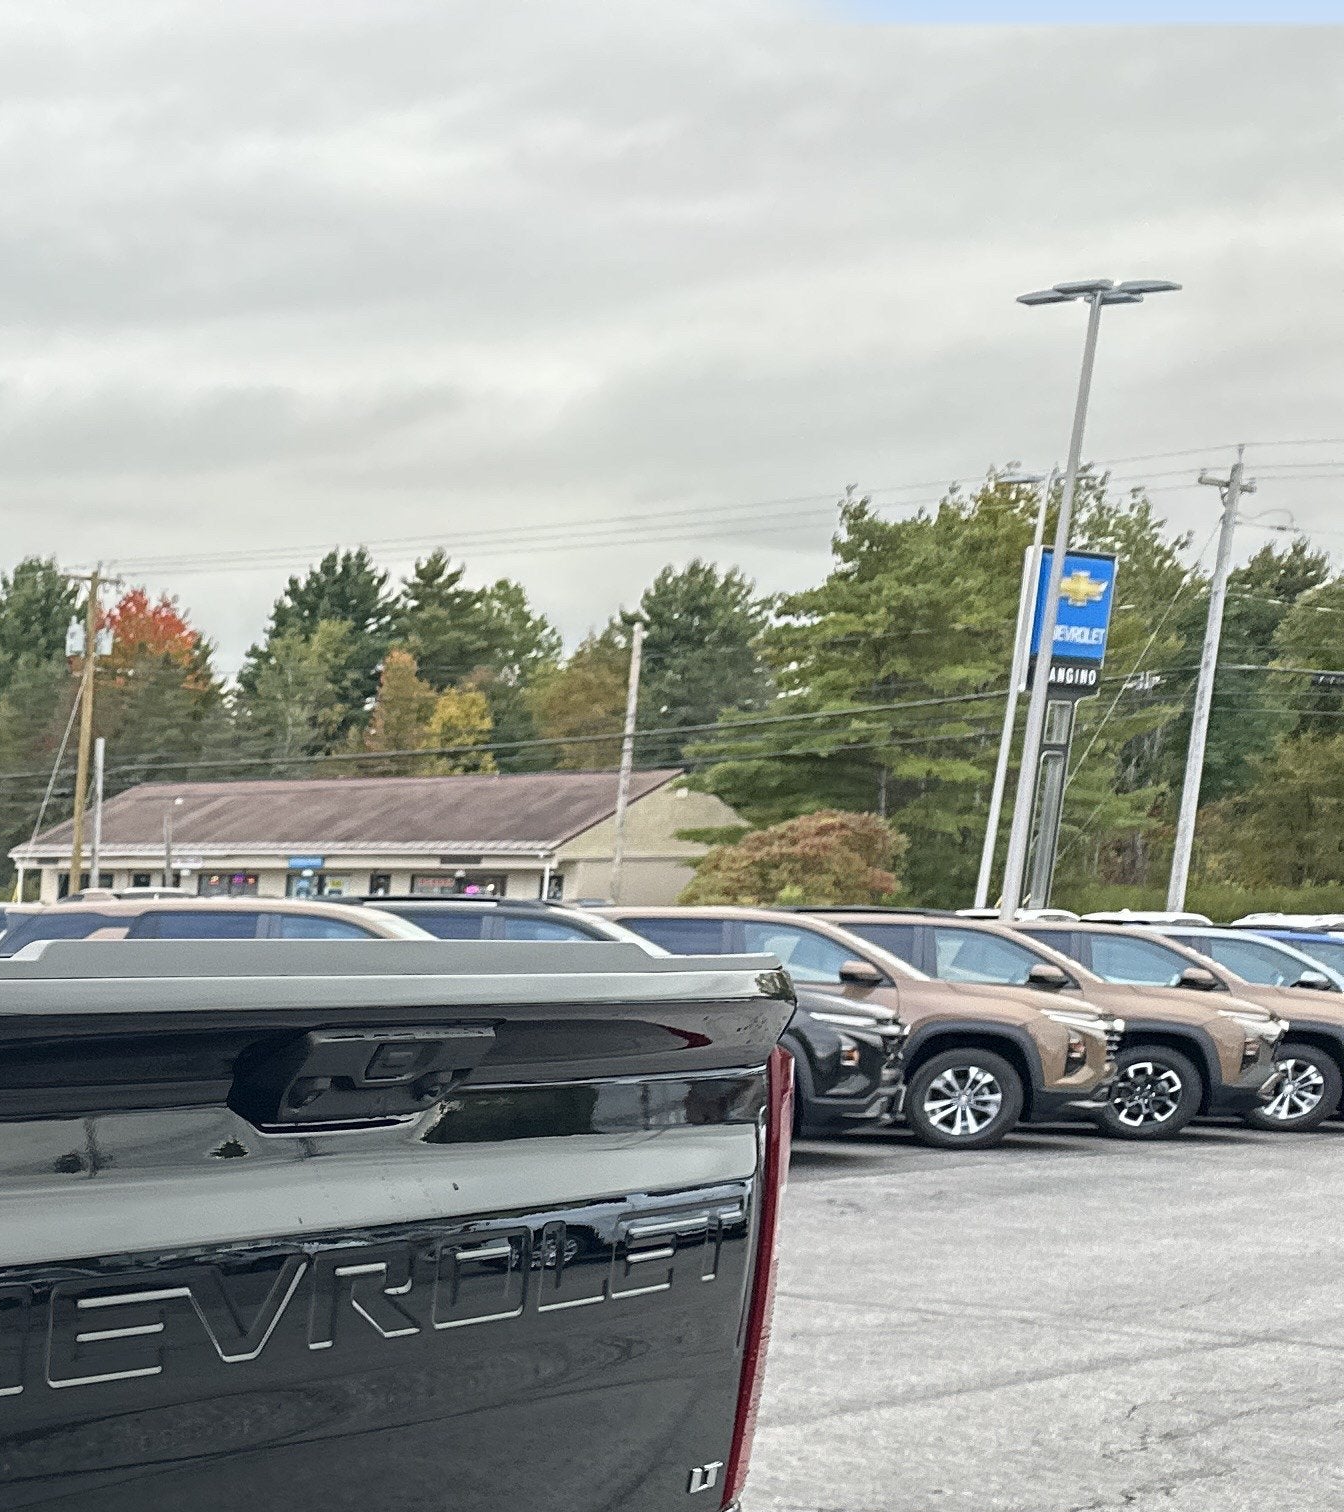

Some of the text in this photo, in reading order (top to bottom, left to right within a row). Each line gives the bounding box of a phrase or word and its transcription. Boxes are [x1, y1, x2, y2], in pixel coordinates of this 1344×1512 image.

[1053, 625, 1105, 644] EVROLET
[1049, 667, 1096, 685] ANGINO
[688, 1460, 724, 1494] LT
